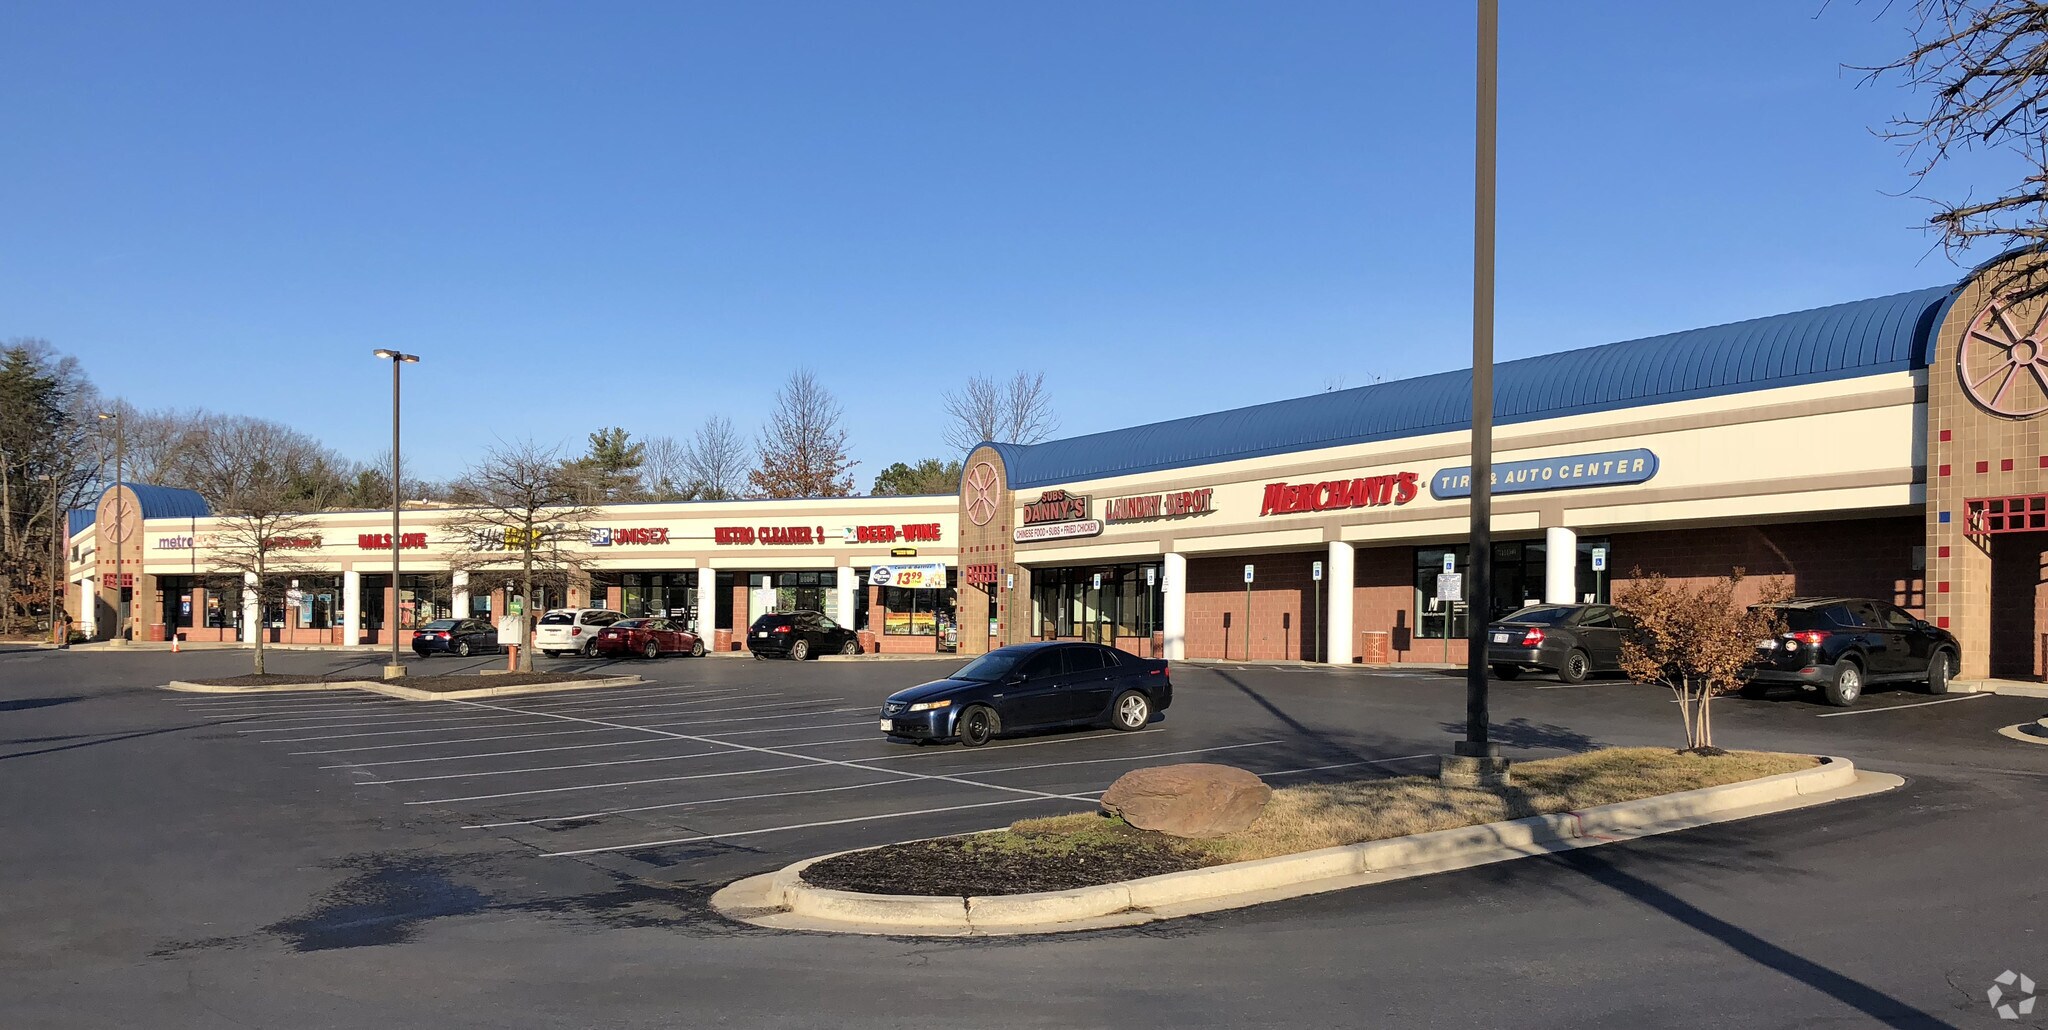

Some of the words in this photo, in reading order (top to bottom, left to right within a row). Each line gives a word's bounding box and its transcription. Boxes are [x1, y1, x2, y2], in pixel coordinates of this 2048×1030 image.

[1504, 467, 1553, 484] AUTO
[1559, 458, 1645, 478] CENTER
[1042, 490, 1065, 503] SUBS
[1106, 494, 1162, 521] LAUNDRY
[1165, 488, 1214, 516] DEPOT
[1024, 498, 1085, 524] DANNY'S
[613, 528, 670, 545] UNISEX
[715, 527, 755, 543] METRO
[759, 527, 813, 544] CLEANER
[817, 526, 825, 543] 2
[1016, 528, 1034, 539] CHINESE
[1034, 527, 1046, 537] FOOD
[1049, 525, 1061, 536] SUBS
[1063, 523, 1076, 534] FRIED
[1077, 521, 1098, 533] CHICKEN
[359, 534, 393, 549] NAILS
[1428, 597, 1438, 611] M
[1583, 593, 1596, 604] M
